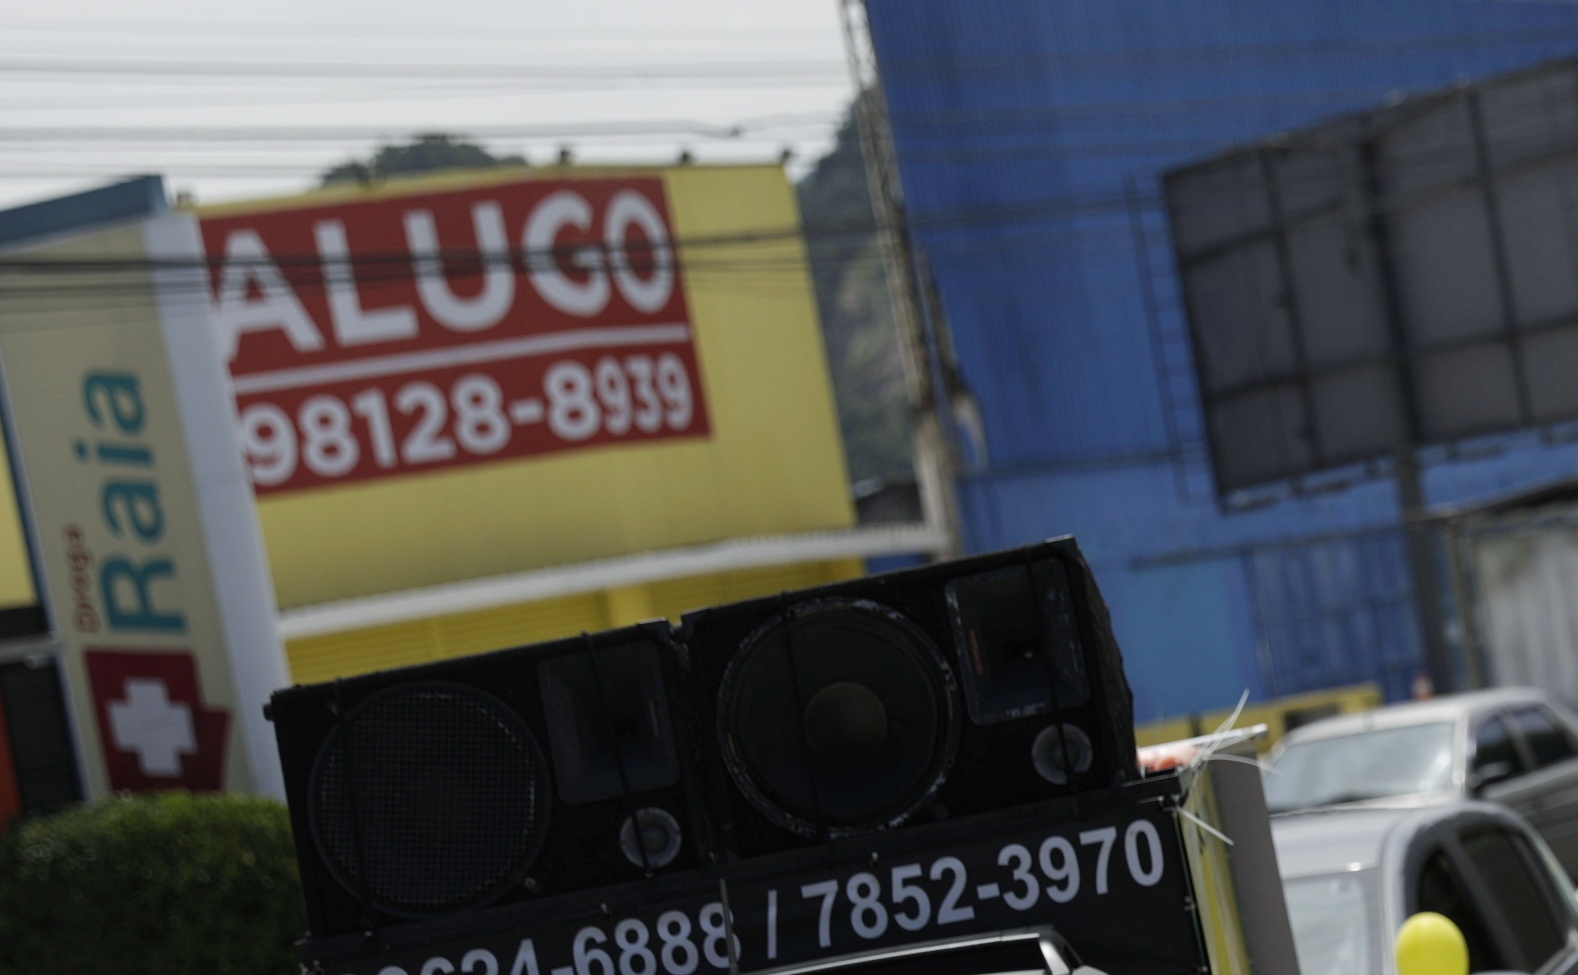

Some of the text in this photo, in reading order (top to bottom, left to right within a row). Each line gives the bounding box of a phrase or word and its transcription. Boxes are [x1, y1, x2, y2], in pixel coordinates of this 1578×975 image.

[217, 188, 676, 362] ALUGO
[240, 351, 694, 486] 98128-8939
[72, 368, 188, 636] Raia
[62, 521, 101, 634] Droga
[801, 818, 1165, 949] 7852-3970
